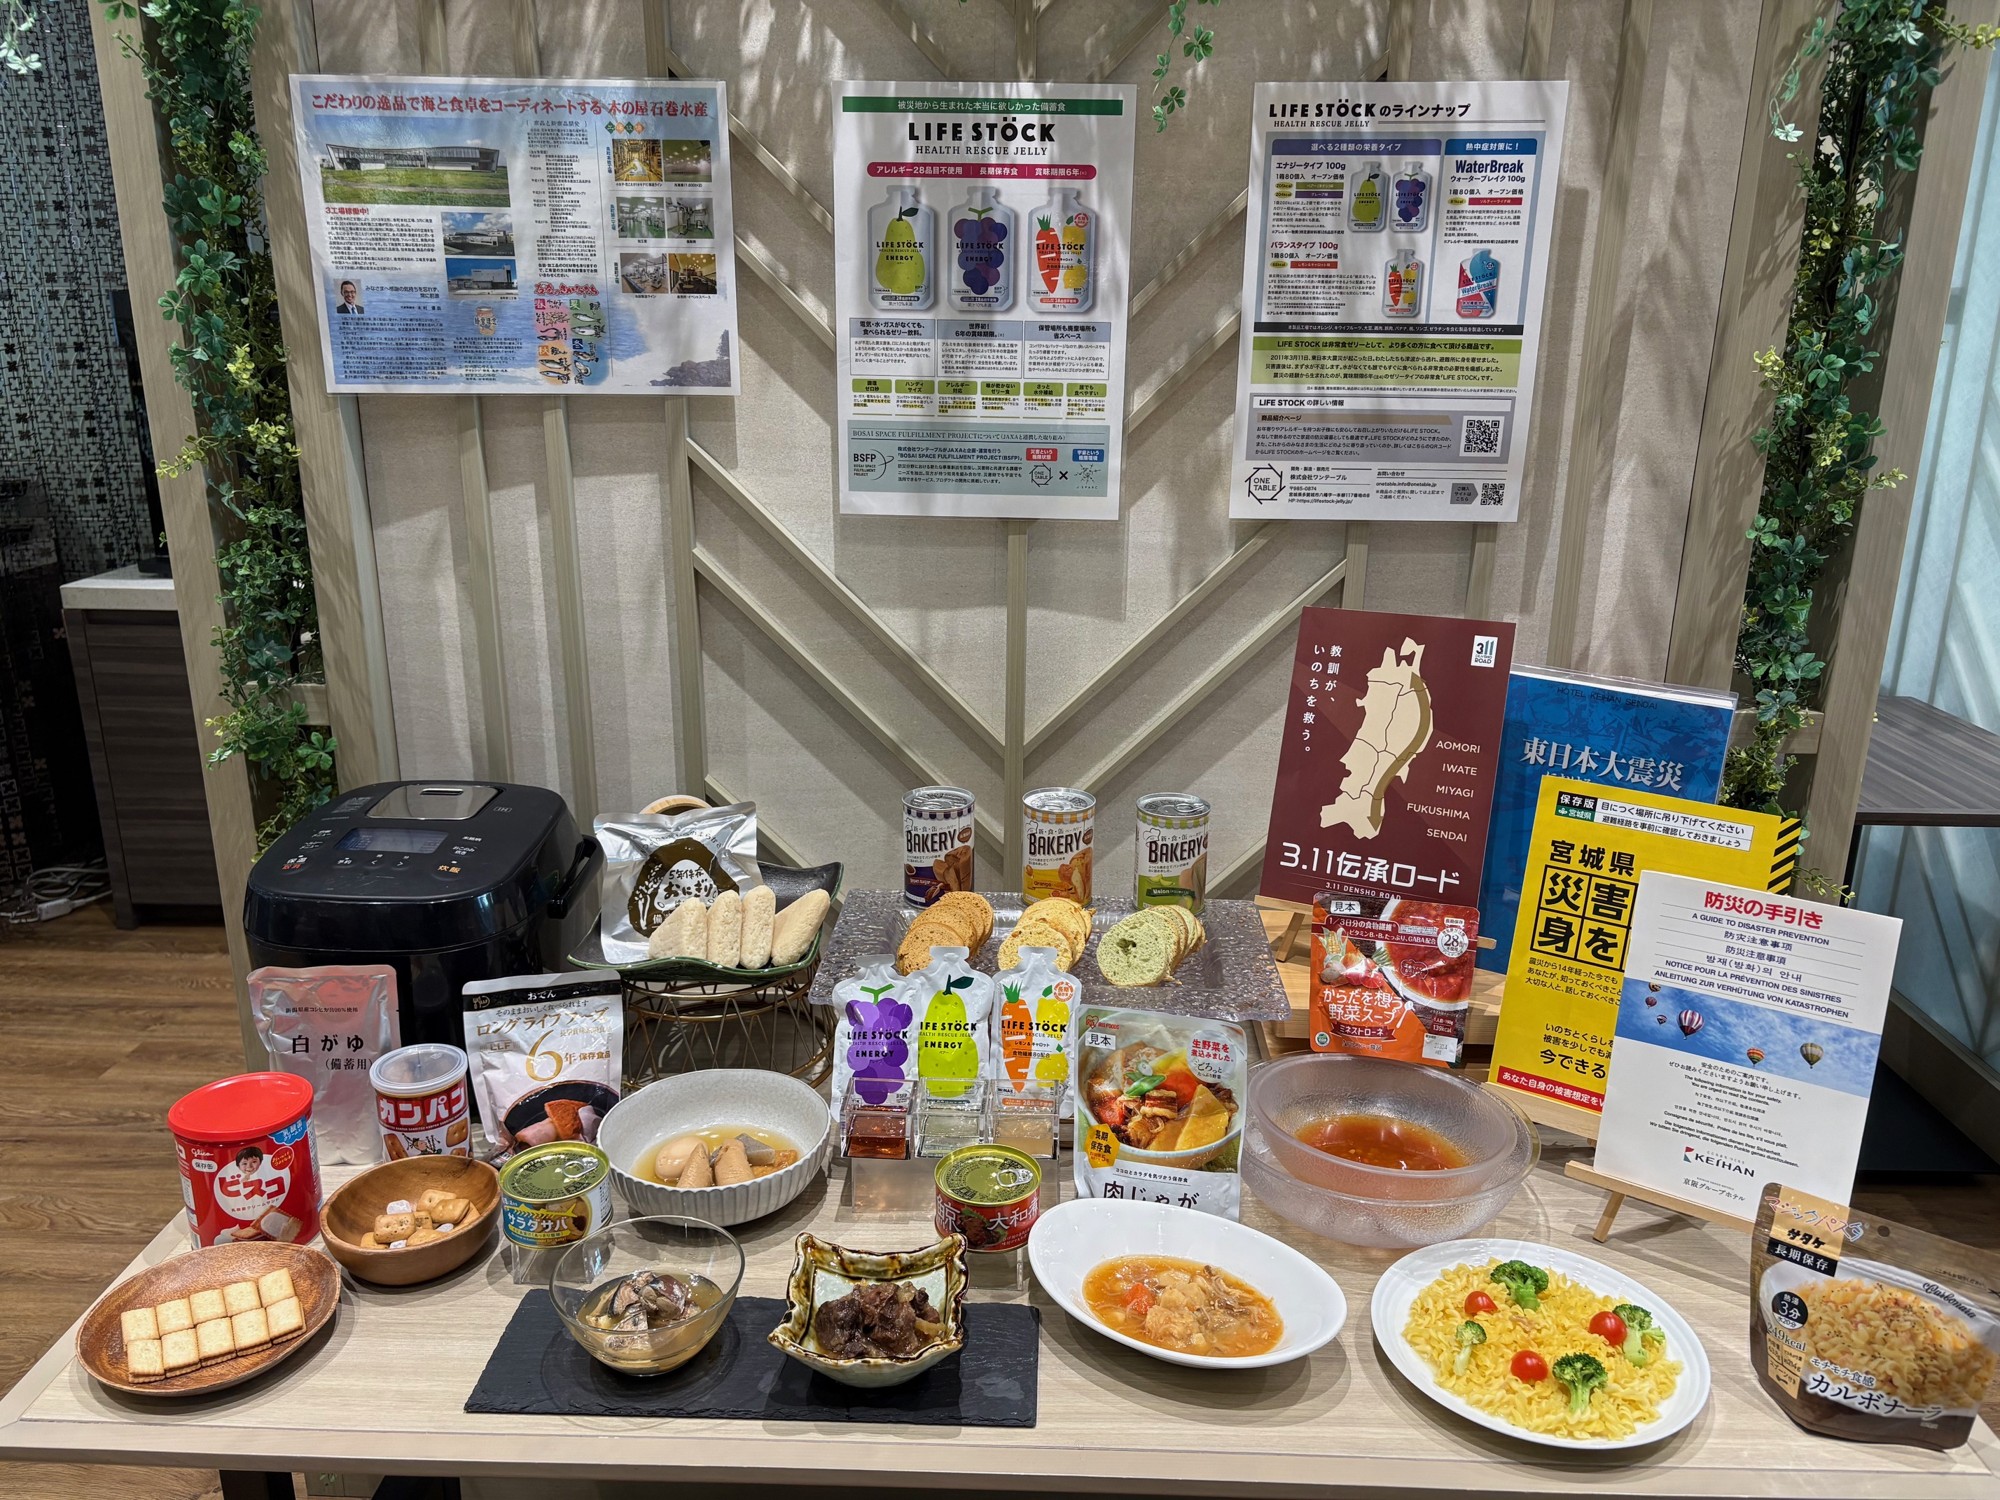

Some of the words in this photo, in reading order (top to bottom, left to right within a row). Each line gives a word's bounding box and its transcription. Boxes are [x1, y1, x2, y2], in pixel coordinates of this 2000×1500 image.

[312, 94, 601, 115] こだわりの逸品で海と食卓をコーディネートする
[608, 100, 708, 117] 木の屋石巻水産
[898, 101, 1066, 113] 被災地から生まれた本当に欲しかった備蓄食
[1269, 103, 1310, 117] LIFE
[1315, 99, 1376, 118] STÖCK
[1379, 103, 1471, 117] のラインナップ
[909, 122, 963, 141] LIFE
[971, 117, 1056, 143] STÖCK
[1274, 120, 1306, 128] HEALTH
[1309, 120, 1342, 128] RESCUE
[1344, 120, 1370, 128] JELLY
[916, 145, 961, 155] HEALTH
[966, 146, 1009, 155] RESCUE
[1013, 147, 1048, 157] JELLY
[1310, 143, 1402, 152] 選べる2種類の栄養タイプ
[876, 165, 963, 175] アレルギー28品目不使用
[979, 166, 1019, 176] 長期保存食
[1275, 161, 1323, 170] エナジータイプ
[1326, 161, 1346, 170] 100g
[1455, 159, 1524, 174] WaterBreak
[1450, 175, 1506, 183] ウォーターブレイク
[1507, 175, 1526, 183] 100g
[1449, 188, 1481, 196] 1箱80個入
[1487, 188, 1524, 196] オープン価格
[897, 240, 924, 249] STÖCK
[1057, 242, 1085, 251] STÖCK
[1271, 241, 1316, 249] バランスタイプ
[1319, 241, 1339, 250] 100g
[860, 320, 925, 329] 電気・水・ガスがなくても、
[863, 328, 922, 337] 食べられるゼリー飲料。
[1038, 325, 1097, 333] 保管場所も廃棄場所も
[1277, 340, 1293, 348] LIFE
[1261, 414, 1302, 422] 商品紹介ページ
[852, 430, 874, 438] BOSAI
[875, 430, 897, 438] SPACE
[898, 431, 946, 439] FULFILLMENT
[853, 453, 877, 463] BSFP
[1324, 644, 1343, 702] 教訓が、
[1301, 644, 1326, 752] いのちを救う。
[1556, 687, 1586, 699] HOTEL
[1590, 692, 1622, 705] KEIHAN
[1625, 697, 1658, 710] SENDAI
[1435, 739, 1481, 754] AOMORI
[1442, 763, 1478, 776] IWATE
[1520, 735, 1685, 792] 東日本大震災
[1435, 784, 1474, 798] MIYAGI
[1560, 793, 1595, 810] 保存版
[1406, 802, 1470, 820] FUKUSHIMA
[1568, 808, 1592, 820] 宮城県
[1601, 801, 1745, 836] 目につく場所に吊り下げてください
[1426, 827, 1468, 843] SENDAI
[1602, 815, 1742, 848] 避難経路を事前に確認しておきましょう
[906, 829, 957, 853] BAKERY
[1028, 830, 1082, 856] BAKERY
[1148, 834, 1203, 864] BAKERY
[1549, 839, 1635, 877] 宮城県
[437, 864, 461, 874] 炊飯
[668, 866, 704, 880] 5年保存
[1279, 841, 1460, 894] 3.11伝承ロード
[663, 878, 714, 900] おにぎり
[1325, 881, 1341, 890] 3.11
[1343, 885, 1377, 897] DENSHO
[1379, 892, 1402, 900] ROAD
[1544, 871, 1630, 922] 災害
[1333, 901, 1356, 912] 見本
[1704, 890, 1823, 930] 防災の手引き
[1691, 912, 1698, 920] A
[1699, 914, 1724, 925] GUIDE
[1725, 919, 1736, 927] TO
[1737, 921, 1776, 936] DISASTER
[1778, 929, 1830, 946] PREVENTION
[1443, 934, 1460, 949] 28
[1537, 915, 1615, 963] 身を
[1725, 945, 1787, 966] 防災注意事項
[1528, 956, 1618, 985] 震災から14年経った今でも
[1705, 954, 1773, 976] 방재(방화)의
[1780, 971, 1803, 983] 안내
[1665, 959, 1693, 972] NOTICE
[1694, 965, 1716, 977] POUR
[1717, 969, 1728, 978] LA
[1729, 972, 1779, 990] PRÉVENTION
[1781, 984, 1798, 994] DES
[1799, 988, 1842, 1004] SINISTRES
[527, 991, 557, 1000] おでん
[1322, 988, 1403, 1010] からだを想う
[1654, 969, 1698, 986] ANLEITUNG
[1698, 979, 1715, 989] ZUR
[1716, 982, 1766, 1000] VERHÜTUNG
[1766, 993, 1783, 1004] VON
[1785, 998, 1849, 1019] KATASTROPHEN
[495, 999, 589, 1017] そのままおいしく食べられます
[1328, 1002, 1400, 1024] 野菜スープ
[847, 1031, 868, 1040] LIFE
[871, 1028, 908, 1040] STÖCK
[919, 1021, 938, 1031] IFE
[940, 1019, 977, 1032] STÖCK
[1001, 1020, 1025, 1032] LIFE
[1028, 1019, 1067, 1034] STÖCK
[1339, 1024, 1385, 1037] ミネストローネ
[291, 1034, 364, 1054] 白がゆ
[924, 1040, 963, 1049] ENERGY
[1089, 1033, 1112, 1047] 見本
[1192, 1039, 1230, 1053] 生野菜を
[525, 1029, 564, 1082] 6
[563, 1052, 576, 1065] 年
[578, 1050, 611, 1061] 保存食品
[855, 1050, 895, 1058] ENERGY
[1191, 1049, 1235, 1062] 煮込みました。
[1539, 1048, 1607, 1080] 今できる
[1700, 1061, 1769, 1085] 安全のためのご案内です。
[1668, 1060, 1801, 1100] ぜひお読みくださいますようお願い申し上げます。
[379, 1086, 465, 1125] カンパン
[1095, 1129, 1109, 1142] 長期
[1090, 1141, 1112, 1154] 保存食
[195, 1160, 214, 1170] 保存缶
[1694, 1152, 1755, 1178] KEIHAN
[218, 1173, 286, 1201] ビスコ
[507, 1212, 568, 1233] サラダサバ
[1787, 1228, 1826, 1250] サタケ
[1774, 1243, 1829, 1272] 長期保存
[1778, 1300, 1801, 1320] 3分
[1766, 1321, 1806, 1352] 249kcal
[1811, 1356, 1875, 1388] モチモチ食感
[1809, 1373, 1944, 1419] カルボナーラ
